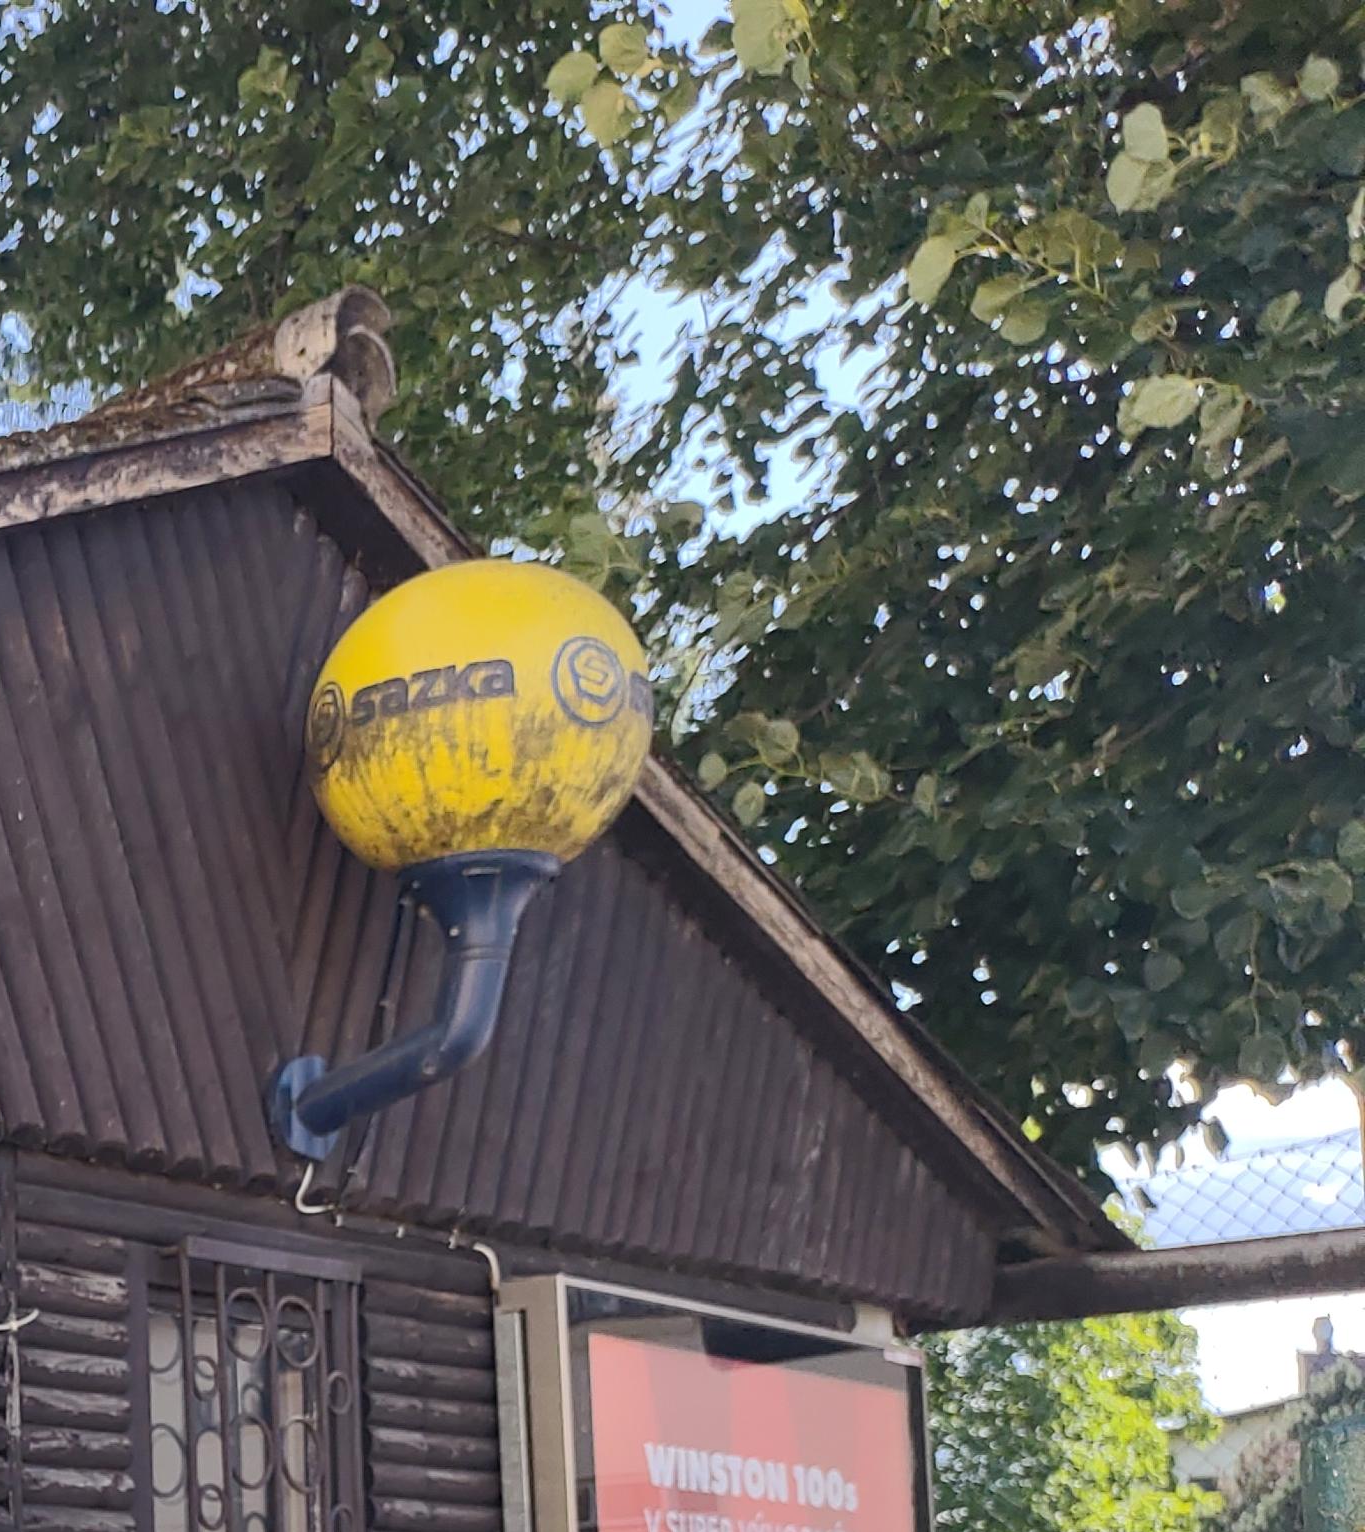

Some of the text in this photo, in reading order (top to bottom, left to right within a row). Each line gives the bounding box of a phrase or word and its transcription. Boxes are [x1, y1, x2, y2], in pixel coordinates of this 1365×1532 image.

[352, 658, 515, 727] sazka
[643, 1442, 859, 1512] WINSTON 100s
